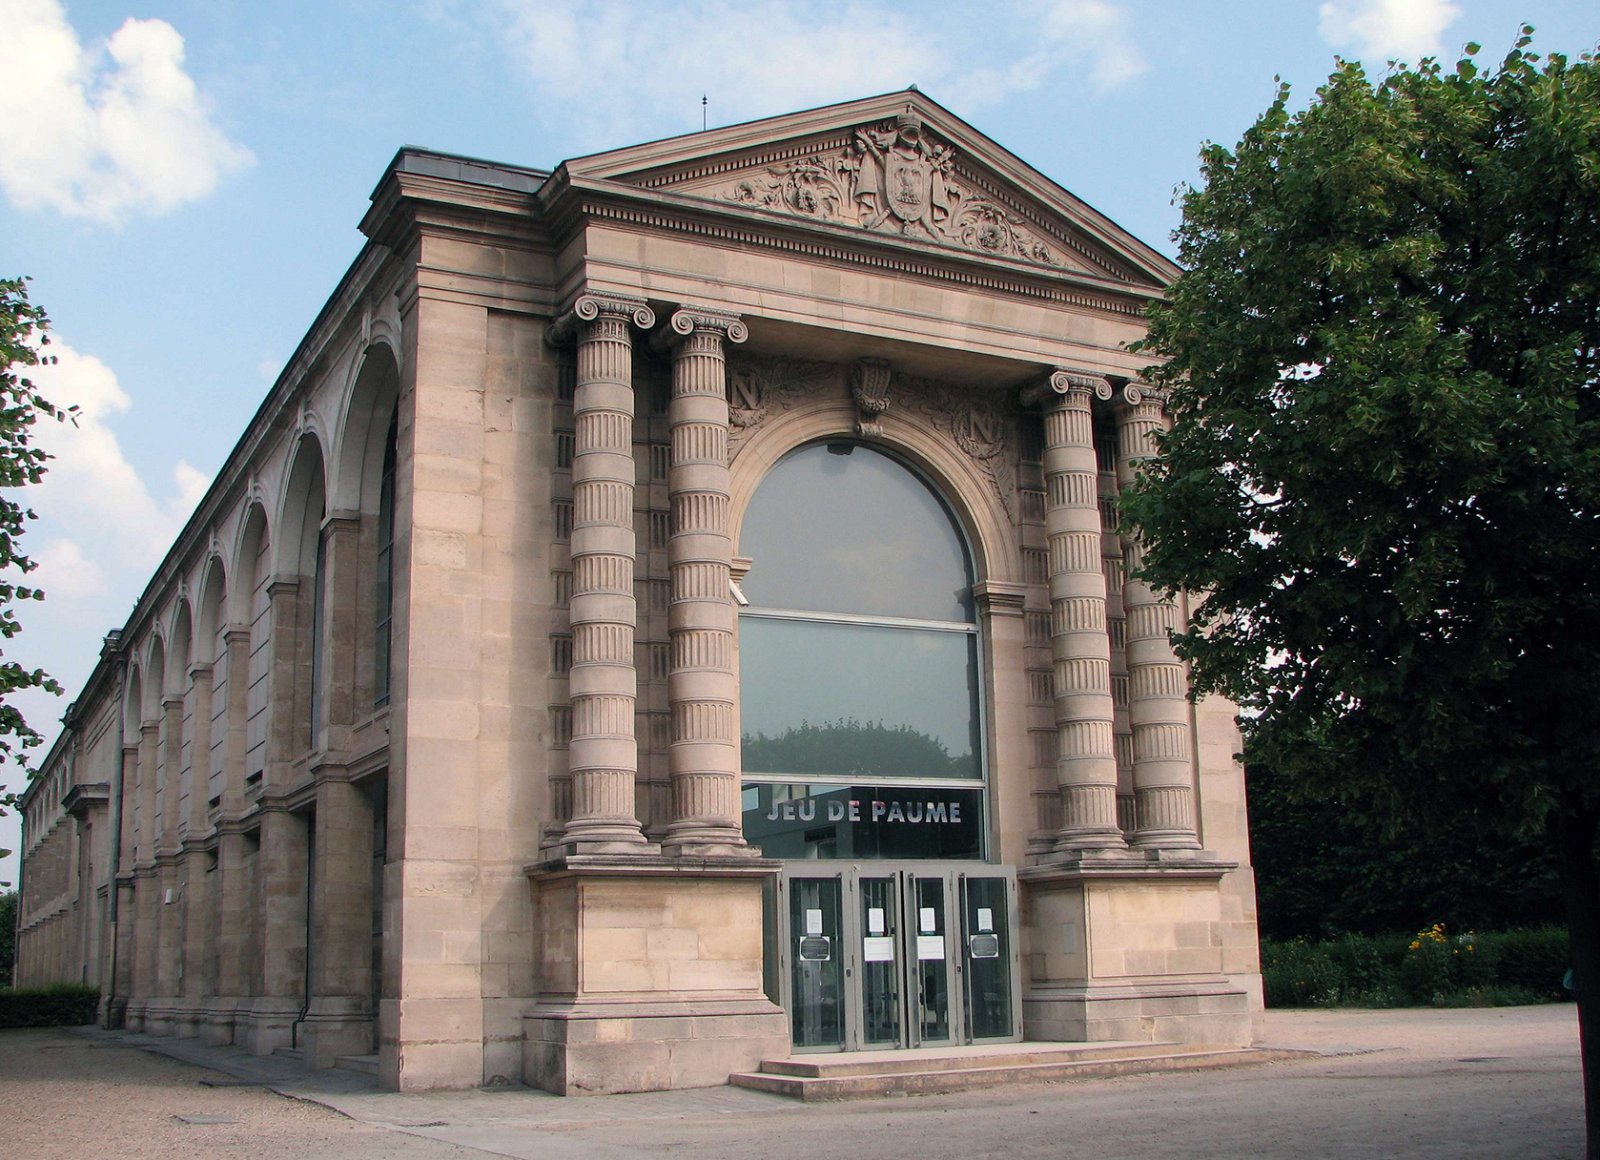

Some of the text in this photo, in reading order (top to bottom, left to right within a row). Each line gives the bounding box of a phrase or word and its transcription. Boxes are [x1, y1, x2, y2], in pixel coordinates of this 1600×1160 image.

[731, 372, 759, 410] N
[970, 407, 993, 444] N
[767, 800, 962, 823] JEU DE PAUME
